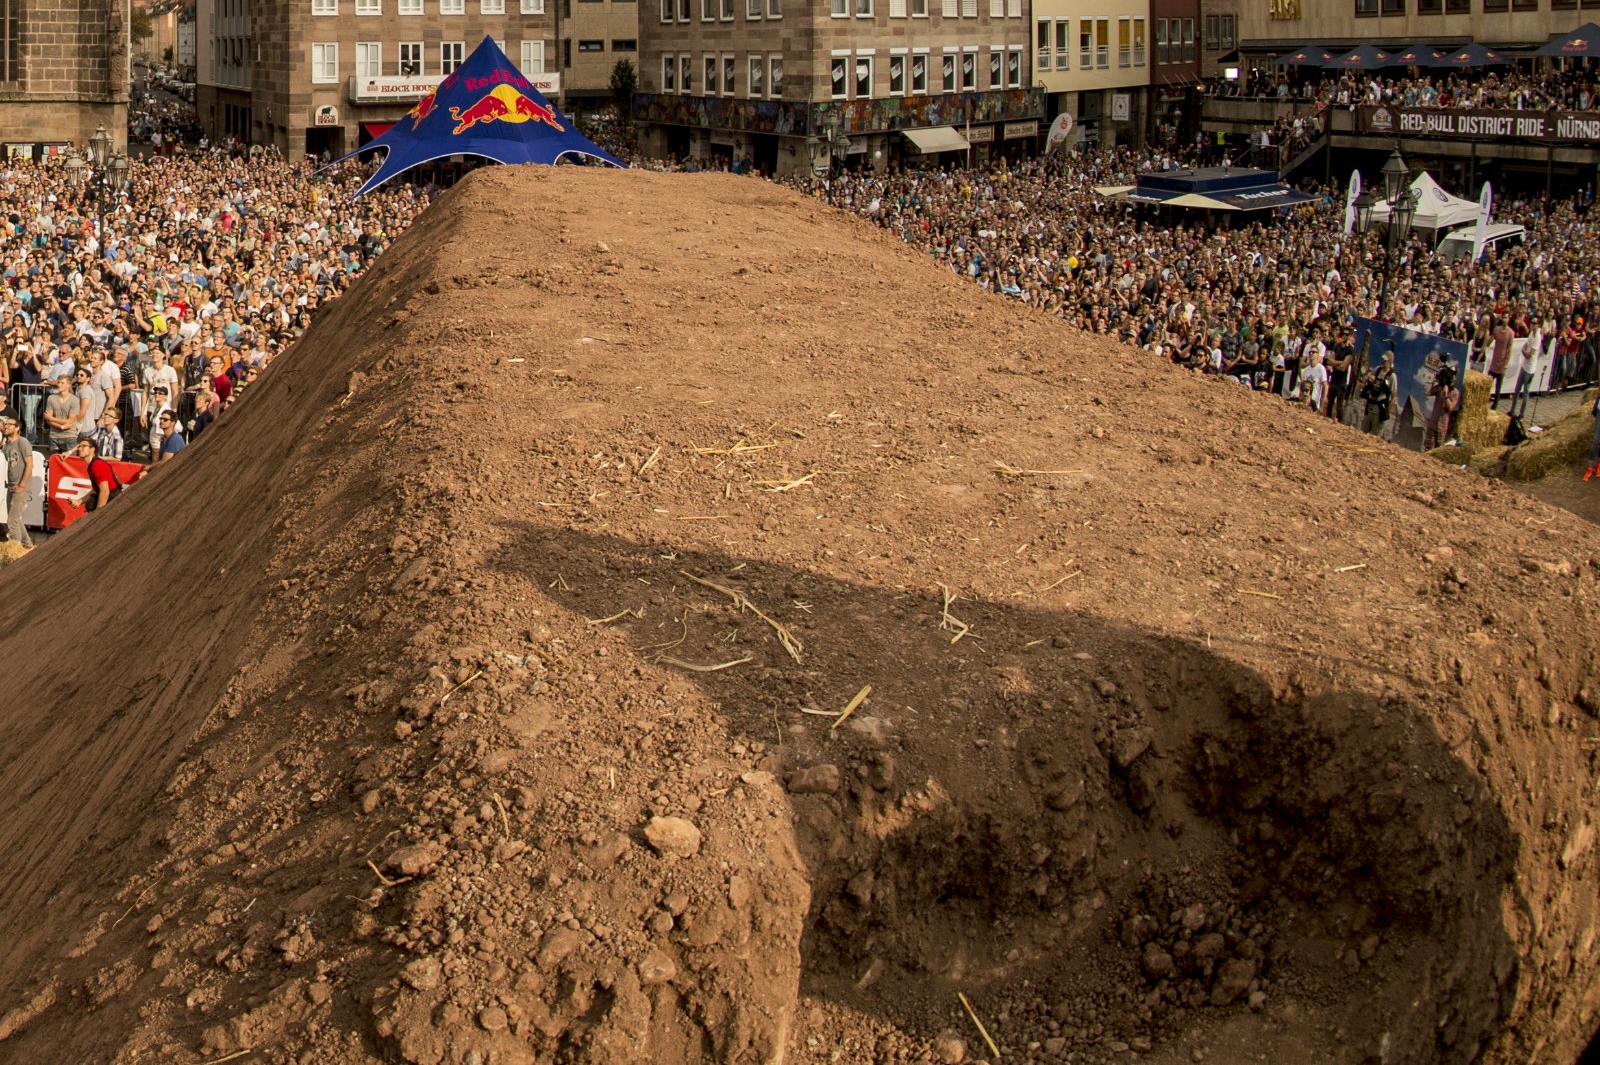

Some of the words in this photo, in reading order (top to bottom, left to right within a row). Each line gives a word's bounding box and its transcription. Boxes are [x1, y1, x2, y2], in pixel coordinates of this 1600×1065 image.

[381, 85, 410, 93] BLOCK
[412, 84, 434, 92] HOUS
[531, 81, 551, 89] OUSE
[465, 67, 500, 92] Red
[1400, 113, 1423, 131] RED
[1427, 114, 1455, 133] BULL
[1458, 115, 1514, 135] DISTRICT
[1516, 117, 1544, 137] RIDE
[1236, 188, 1289, 201] Tucher
